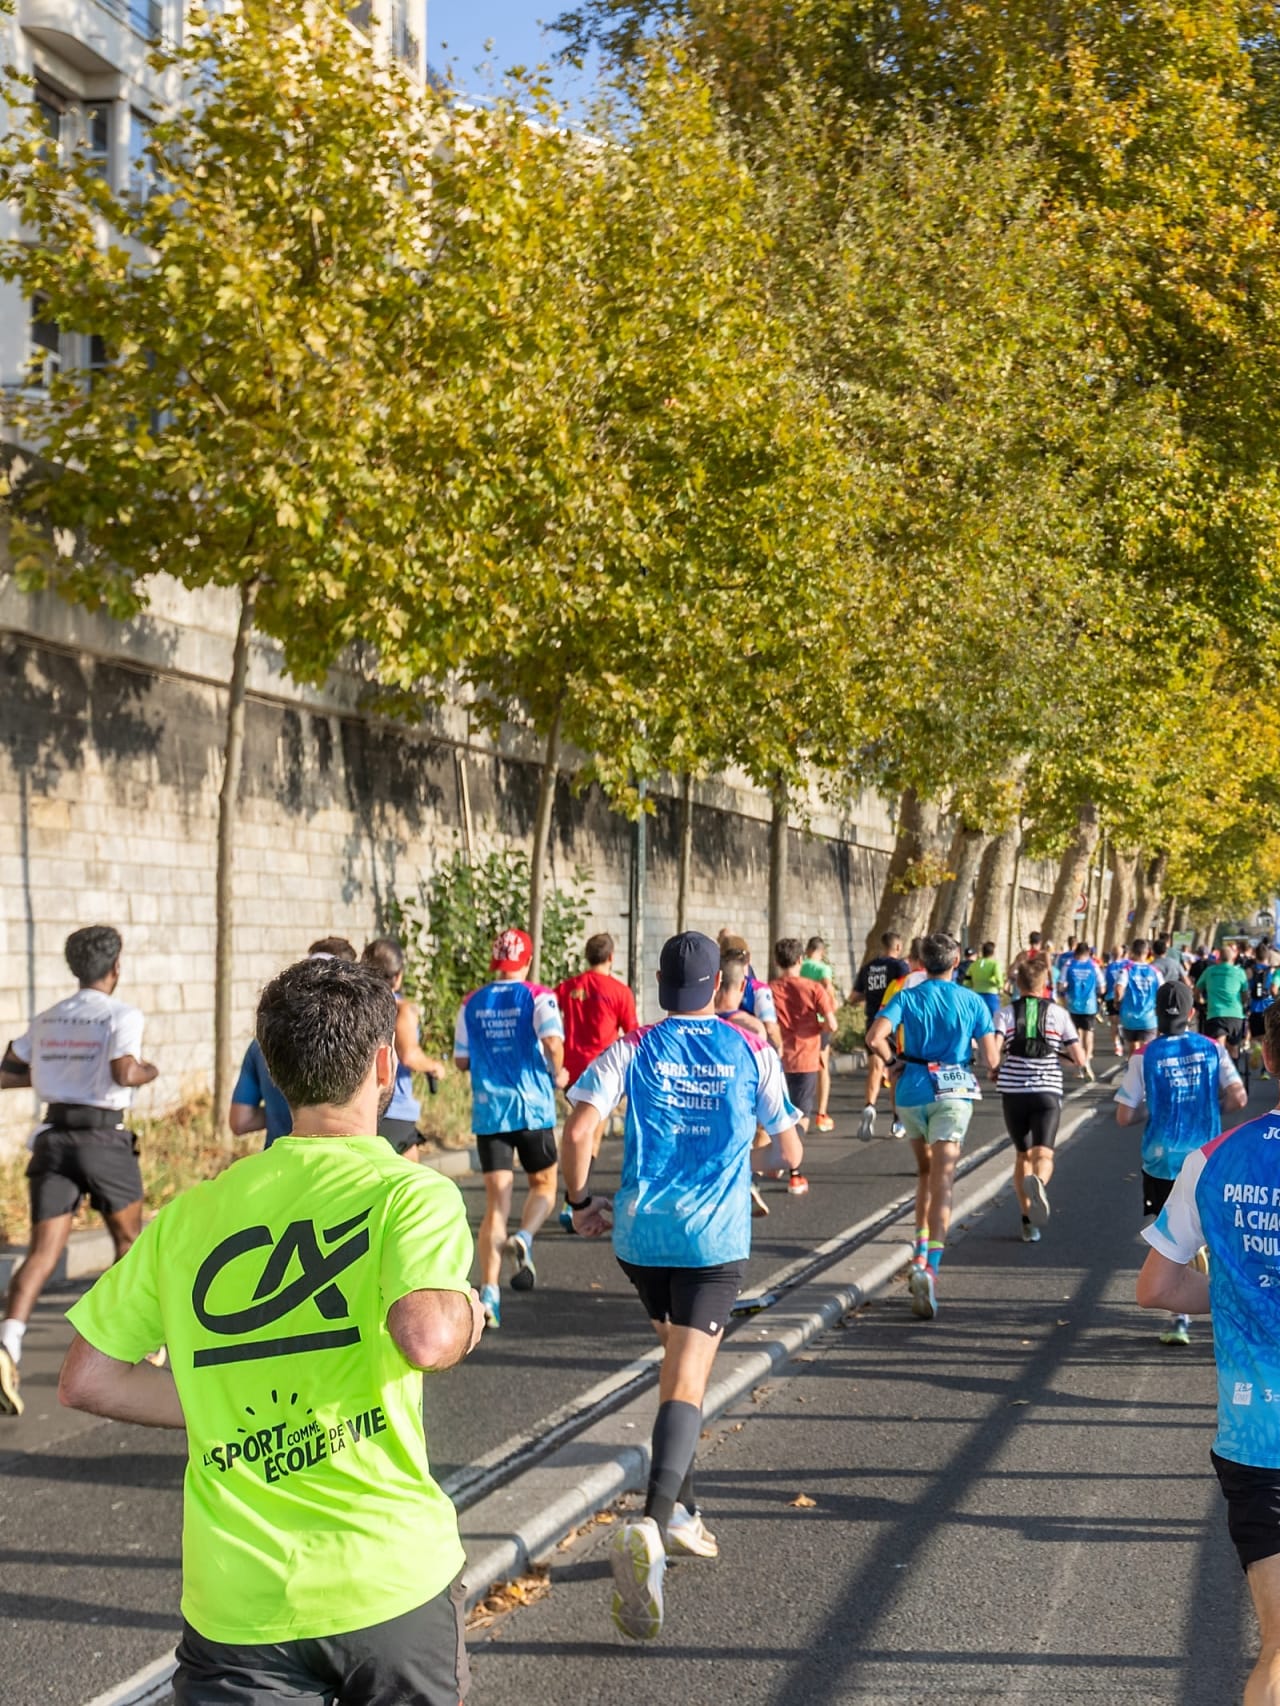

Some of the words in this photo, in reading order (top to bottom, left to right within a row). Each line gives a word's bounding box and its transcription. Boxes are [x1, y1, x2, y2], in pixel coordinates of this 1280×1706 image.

[655, 1061, 689, 1077] PARIS
[1223, 1183, 1269, 1206] PARIS
[1234, 1204, 1245, 1229] À
[329, 1423, 345, 1440] DE
[346, 1406, 387, 1443] VIE
[211, 1422, 287, 1472] SPORT
[287, 1420, 321, 1446] COMME
[330, 1439, 346, 1455] LA
